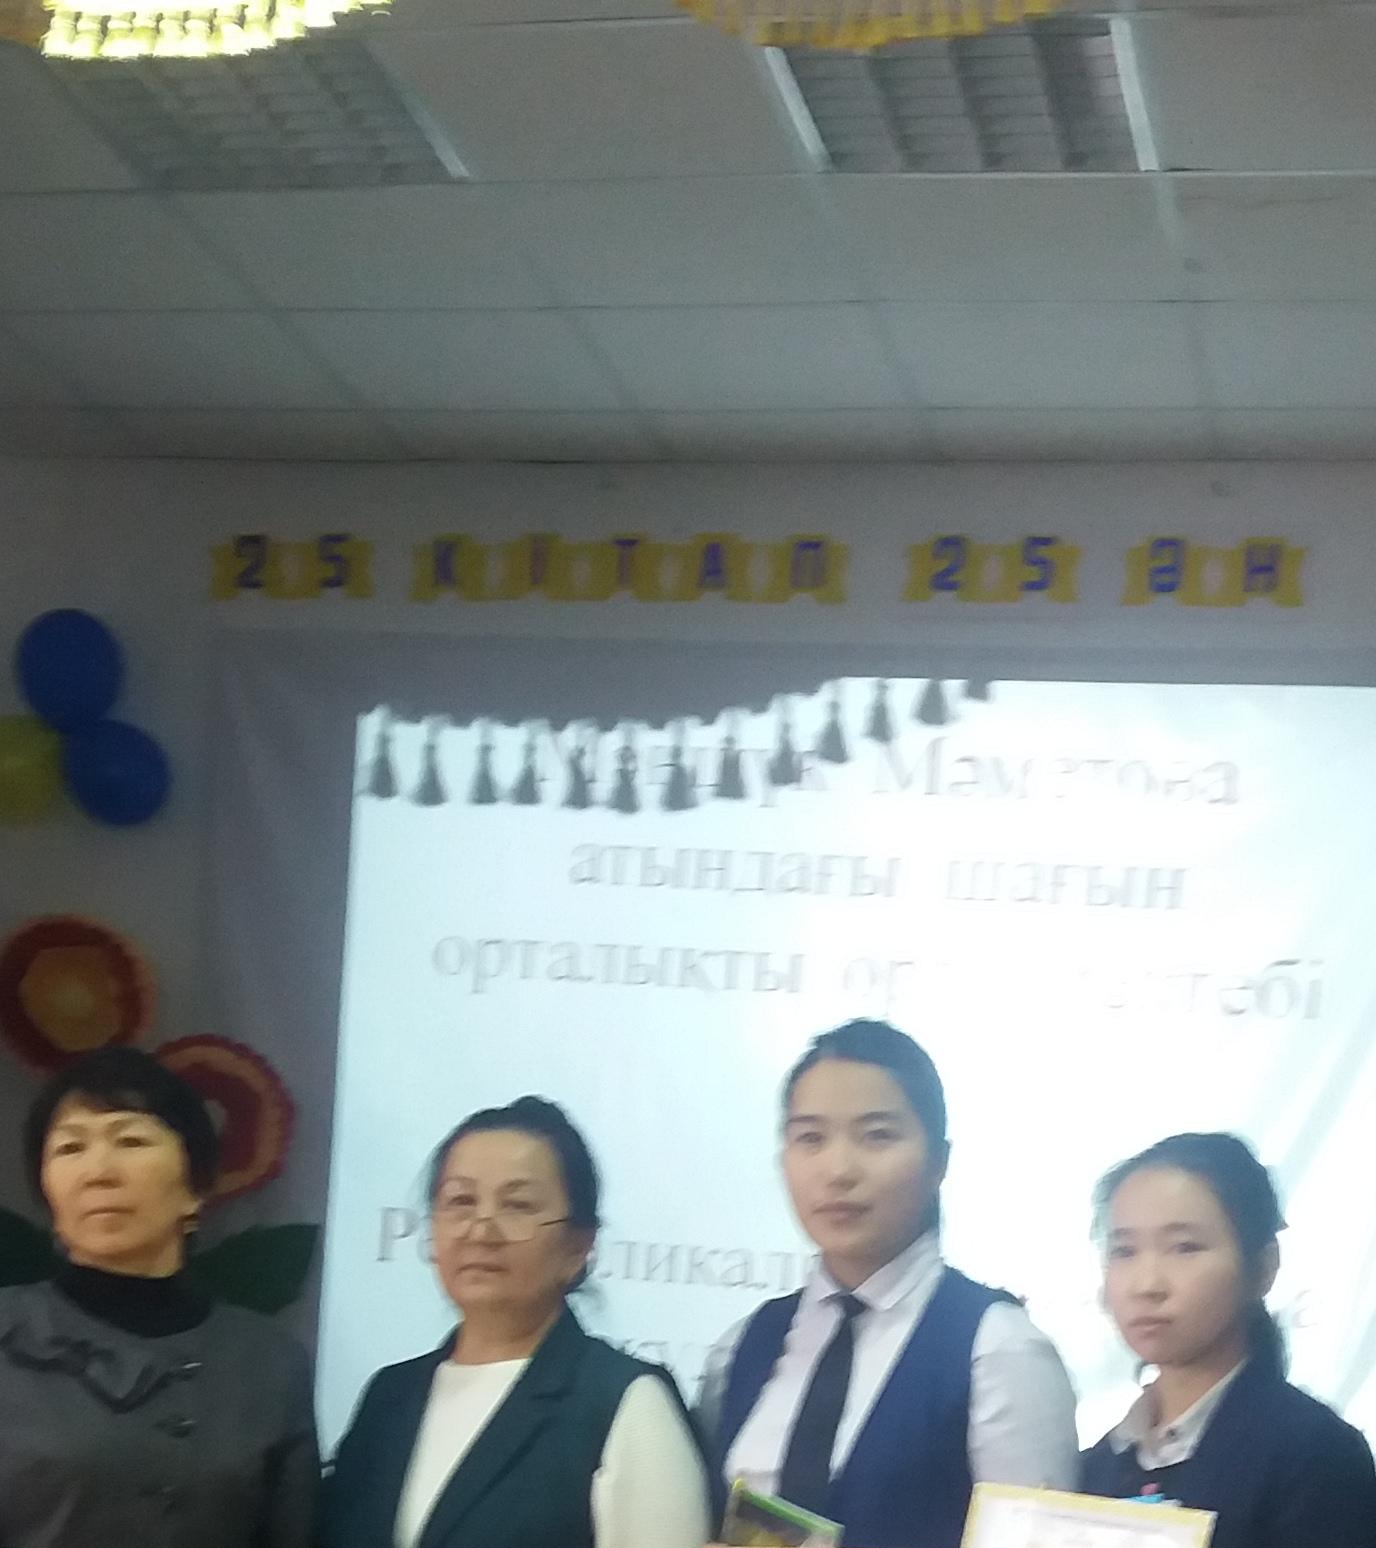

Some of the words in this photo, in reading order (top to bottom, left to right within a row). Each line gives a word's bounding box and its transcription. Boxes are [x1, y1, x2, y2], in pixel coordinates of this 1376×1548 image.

[231, 534, 352, 590] 25
[930, 536, 1056, 592] 25
[568, 842, 902, 899] атындағы
[430, 934, 808, 994] орталықты
